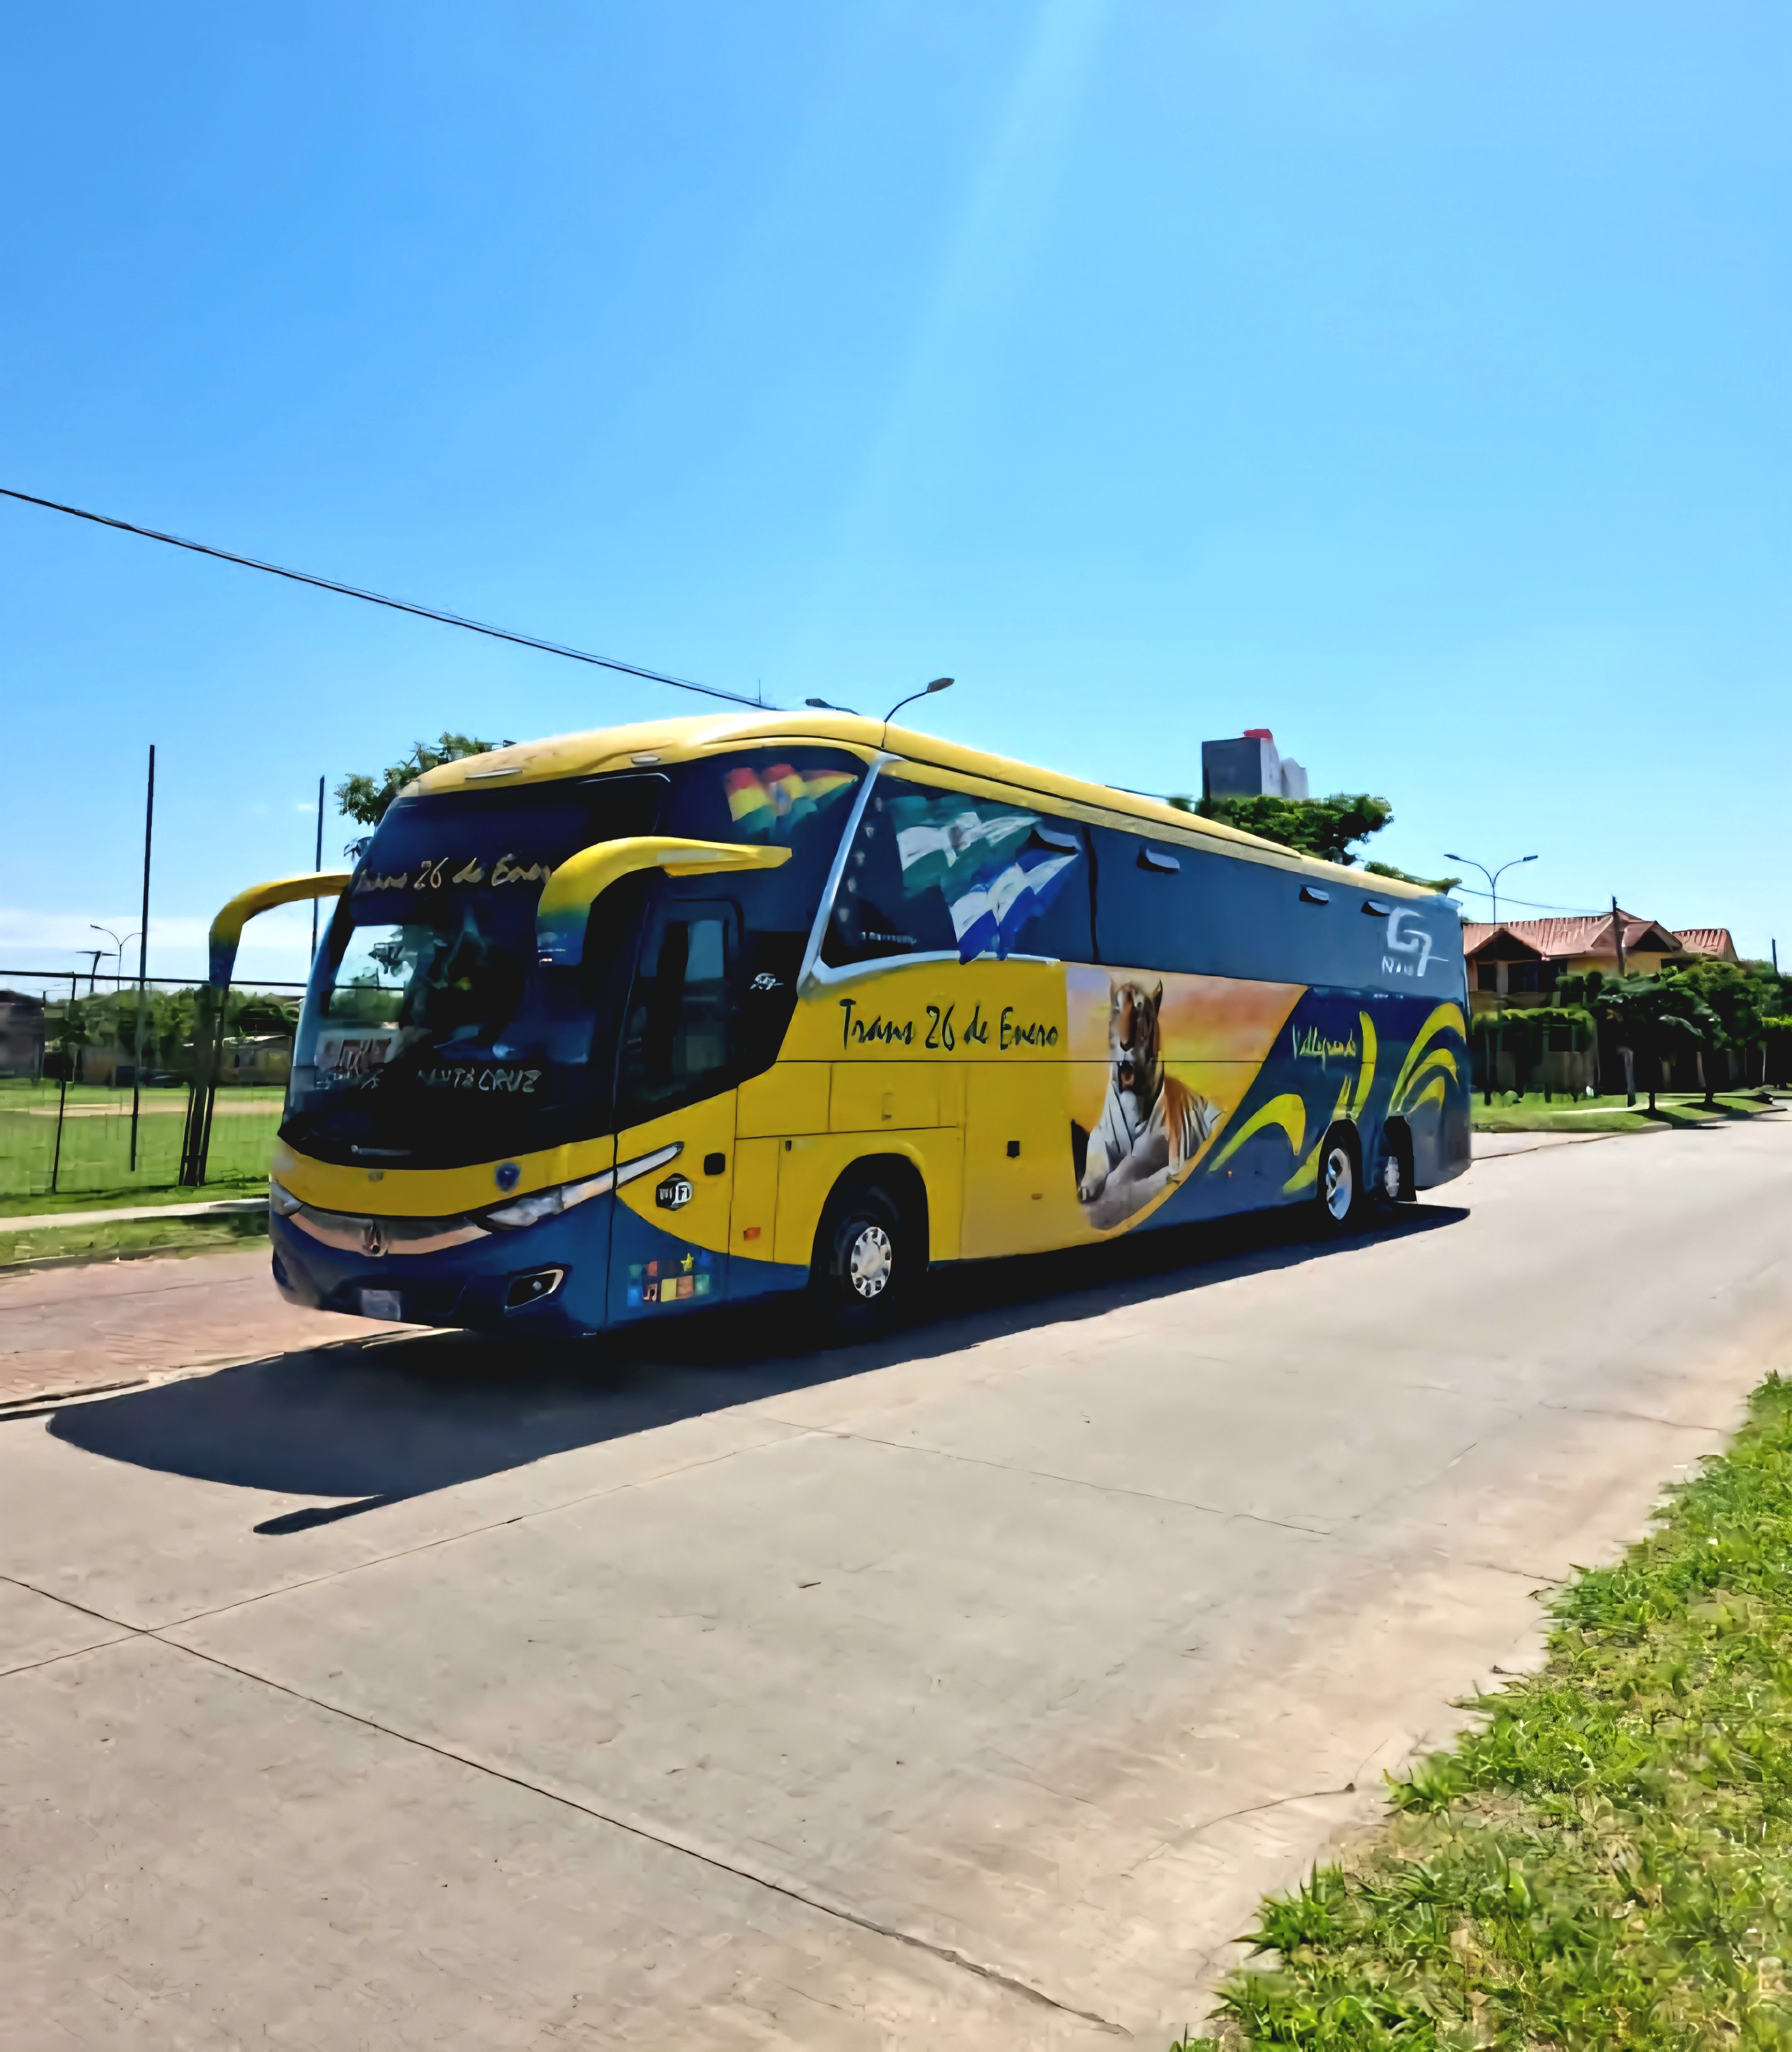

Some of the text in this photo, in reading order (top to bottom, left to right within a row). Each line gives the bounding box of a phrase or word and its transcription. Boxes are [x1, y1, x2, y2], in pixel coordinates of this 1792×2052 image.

[413, 856, 449, 891] 26
[839, 996, 1058, 1051] Trans 26 de Enero
